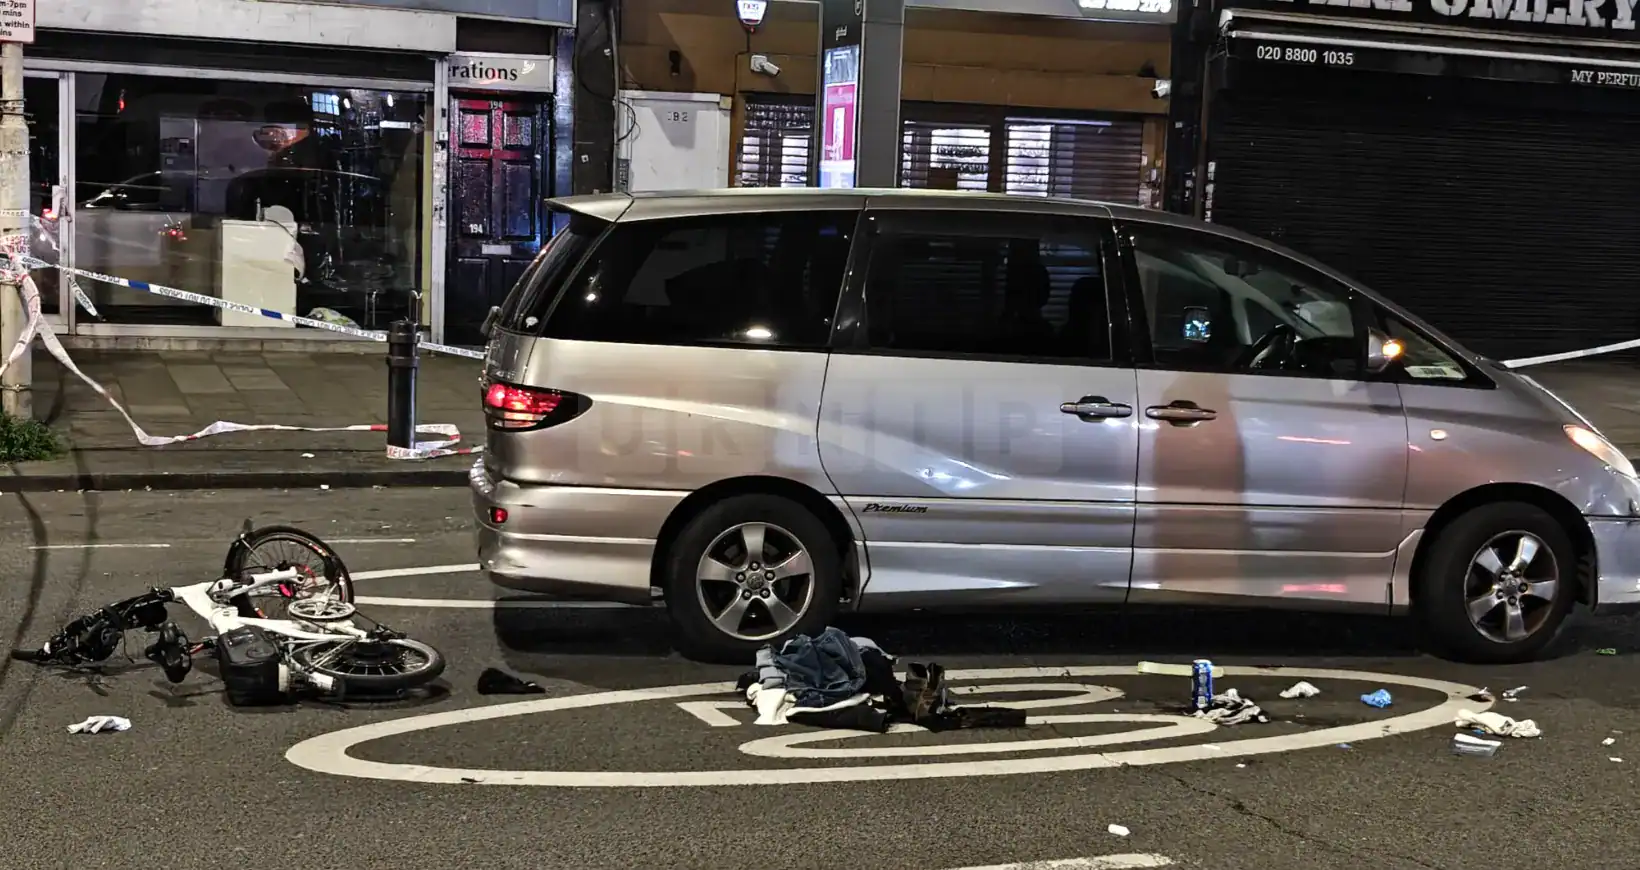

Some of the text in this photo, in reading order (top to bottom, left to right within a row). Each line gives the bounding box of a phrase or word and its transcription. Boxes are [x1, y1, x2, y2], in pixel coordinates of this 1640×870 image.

[2, 9, 22, 17] mins
[4, 19, 30, 28] within
[1257, 45, 1354, 65] 020 8800 1035
[1571, 69, 1640, 87] MY PERFU
[469, 223, 484, 234] 194
[862, 502, 929, 514] Premium
